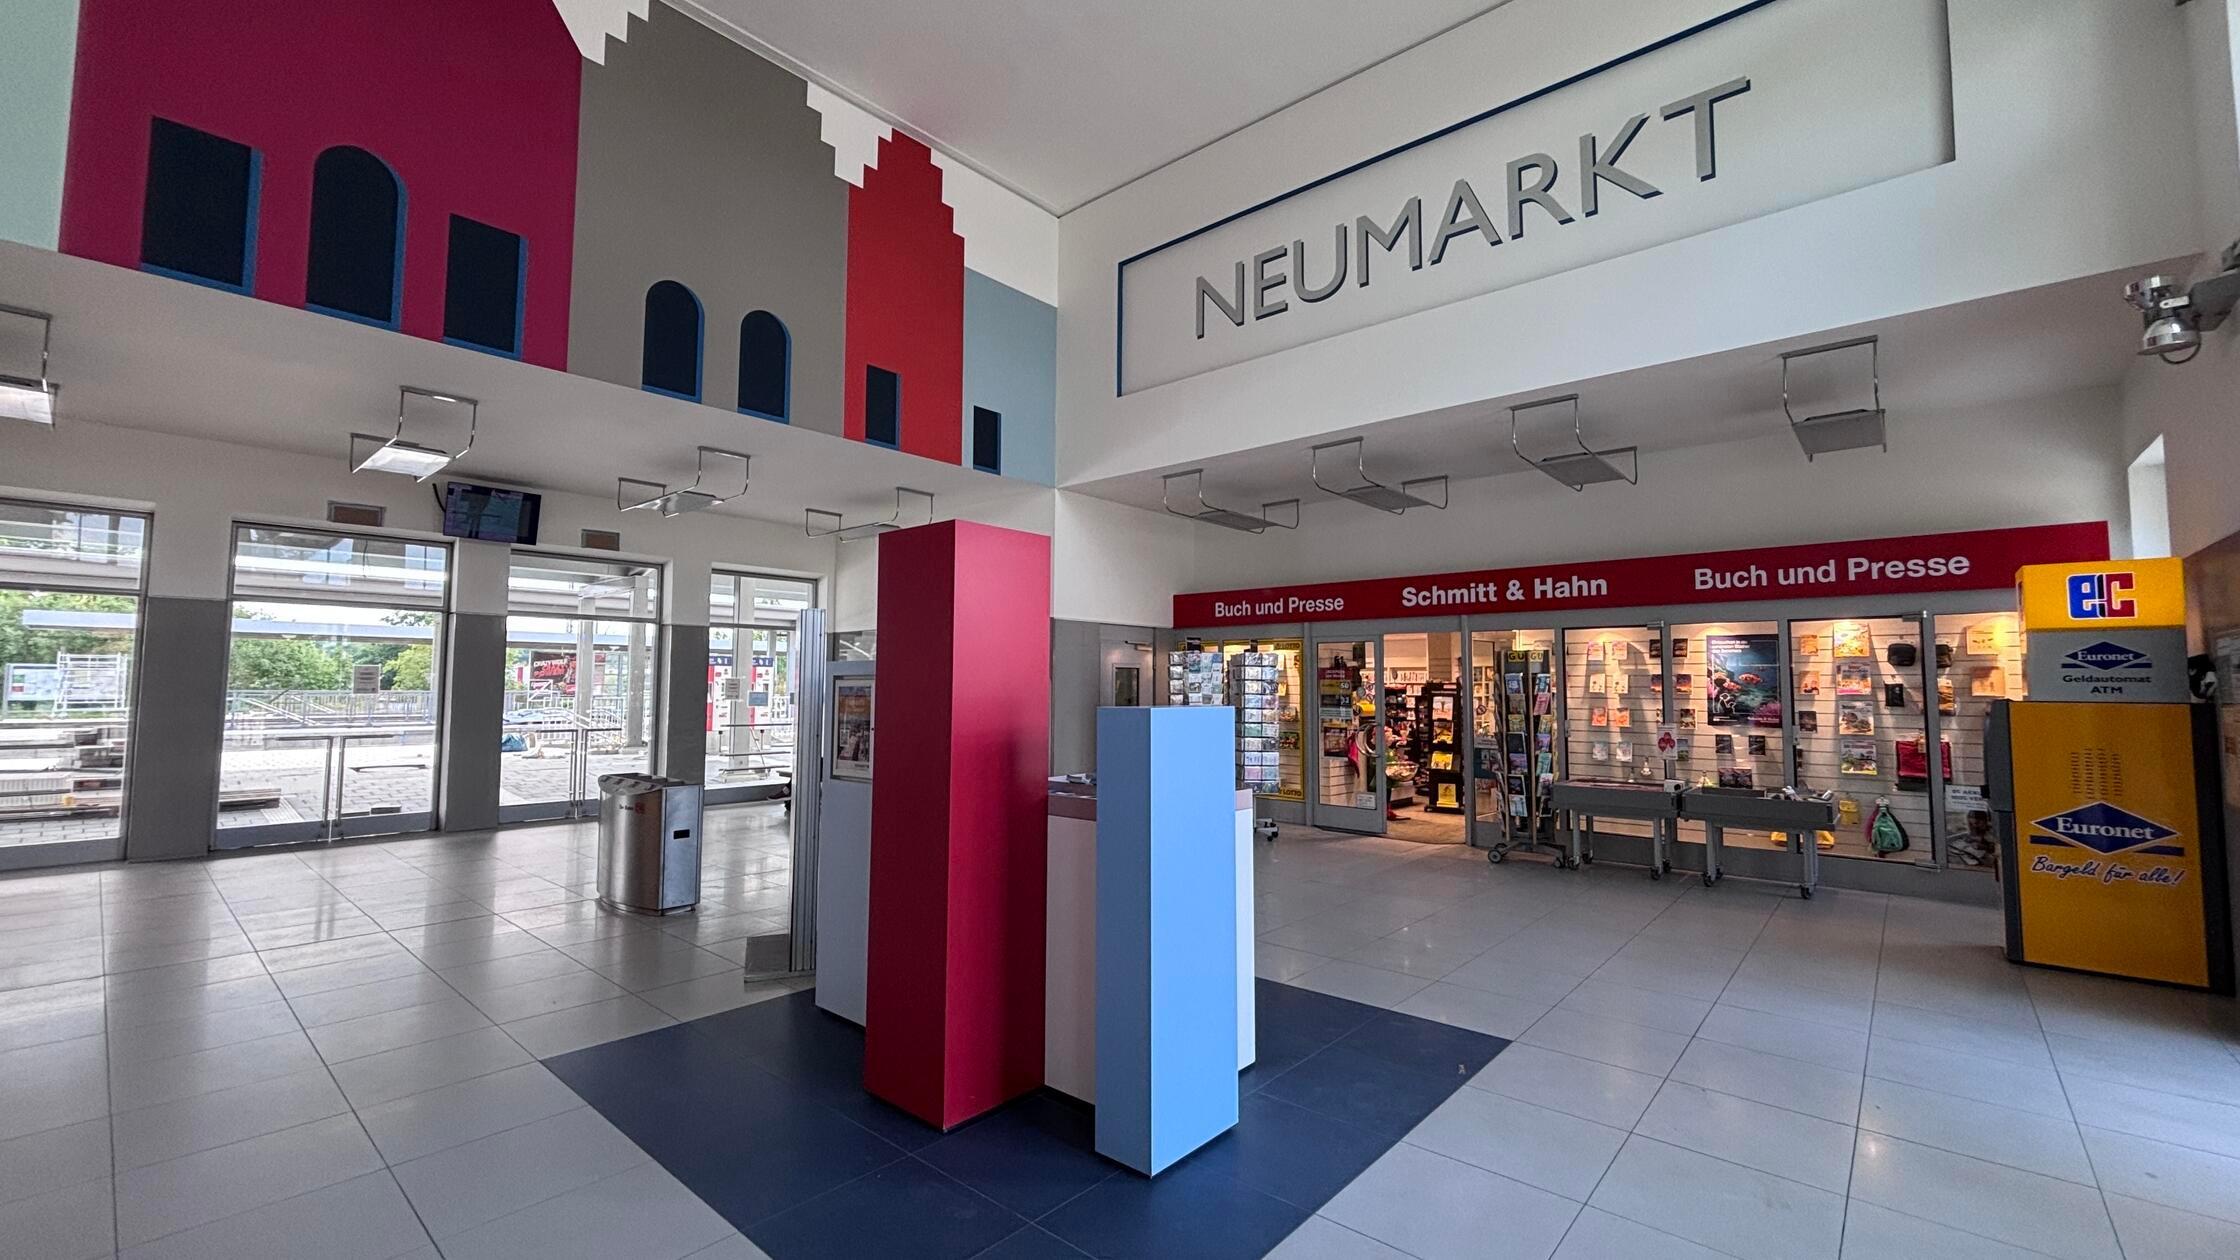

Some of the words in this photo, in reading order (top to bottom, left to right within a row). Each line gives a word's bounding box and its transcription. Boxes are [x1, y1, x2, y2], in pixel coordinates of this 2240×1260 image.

[1196, 76, 1750, 339] NEUMARKT
[1695, 565, 1768, 590] Buch
[1777, 560, 1836, 586] und
[1848, 556, 1970, 581] Presse
[1402, 582, 1498, 606] Schmitt
[1505, 579, 1525, 600] &
[1534, 575, 1608, 599] Hahn
[1215, 601, 1251, 617] Buch
[1255, 598, 1284, 615] und
[1288, 596, 1344, 614] Presse
[2077, 650, 2135, 661] Euronet
[2063, 675, 2152, 683] Geldautomat
[2090, 686, 2123, 694] ATM
[2055, 816, 2157, 840] Euronet
[2031, 855, 2101, 879] Bargeld
[2103, 863, 2133, 884] für
[2138, 866, 2185, 885] alle!
